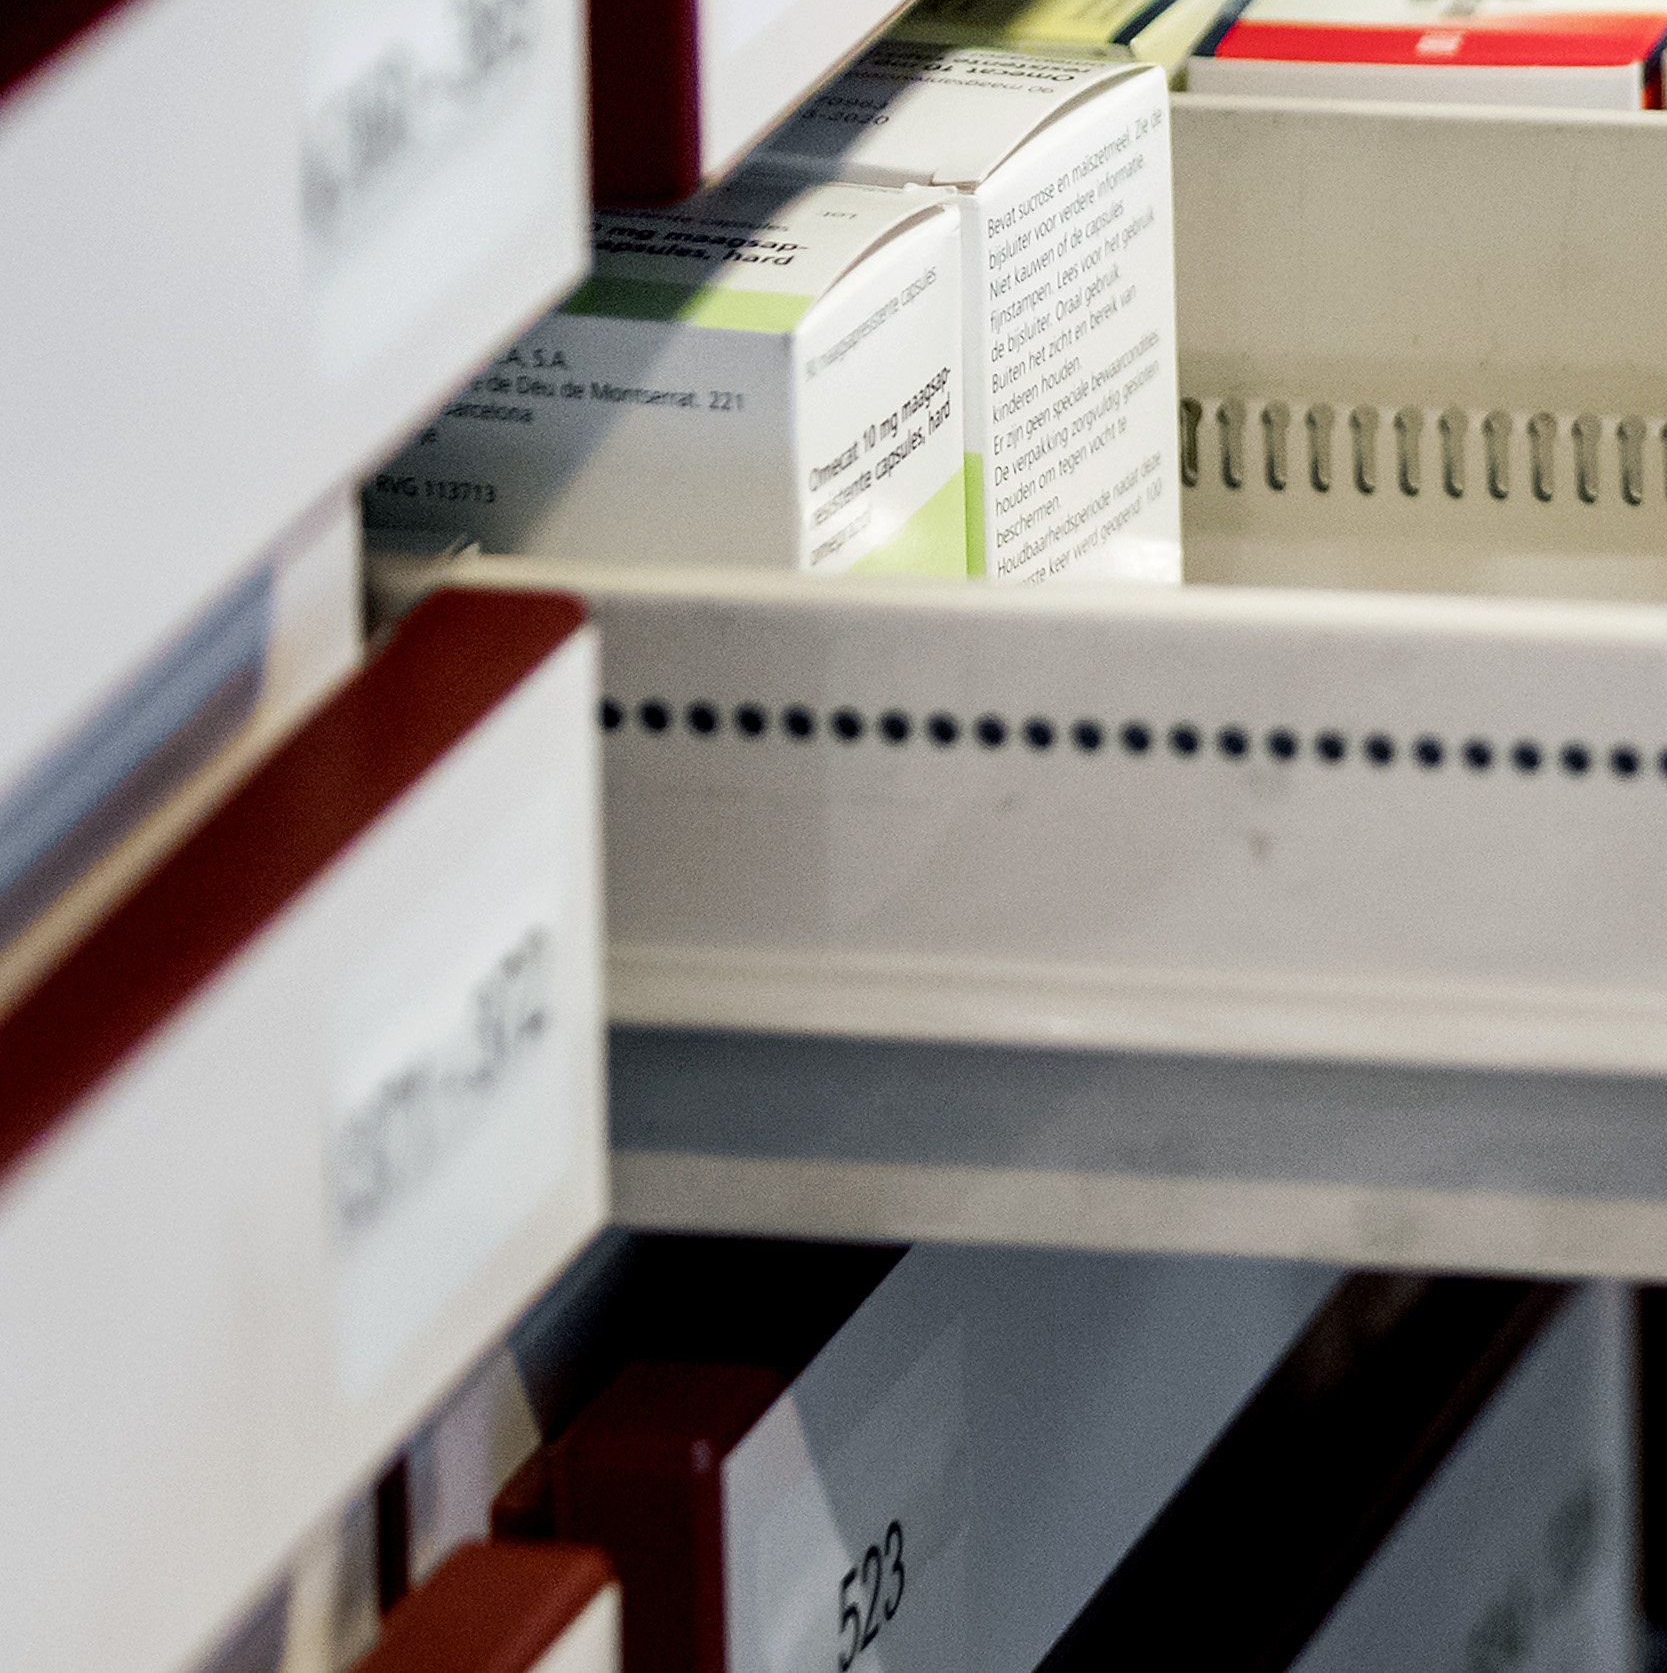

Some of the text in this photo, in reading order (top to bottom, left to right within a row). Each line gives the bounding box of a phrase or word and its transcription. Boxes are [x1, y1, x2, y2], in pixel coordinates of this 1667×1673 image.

[988, 207, 1016, 239] Bevat
[1018, 183, 1055, 219] sucrose
[1057, 173, 1070, 194] en
[989, 153, 1144, 271] bijsluiter voor verdere informatie
[596, 239, 796, 266] apsules, hard
[989, 199, 1125, 302] Niet kauwen of de capsules
[1056, 261, 1080, 290] Lees
[1081, 247, 1103, 273] voor
[1103, 231, 1120, 258] het
[991, 339, 1005, 364] de
[1055, 291, 1083, 323] Oraal
[992, 359, 1026, 395] Buiten
[1028, 346, 1046, 372] het
[1048, 327, 1073, 358] zicht
[1074, 321, 1088, 340] en
[927, 392, 951, 436] hard
[993, 387, 1039, 425] kinderen
[993, 434, 1004, 456] Er
[1006, 420, 1023, 451] zijn
[1025, 407, 1051, 441] geen
[809, 440, 858, 492] Omecat
[863, 423, 876, 452] 10
[879, 411, 898, 440] mg
[994, 463, 1009, 487] De
[1012, 427, 1069, 475] verpakking
[995, 480, 1036, 518] houden
[1038, 466, 1056, 489] om
[1057, 445, 1087, 477] tegen
[1088, 426, 1116, 454] vocht
[838, 1519, 905, 1673] 523
